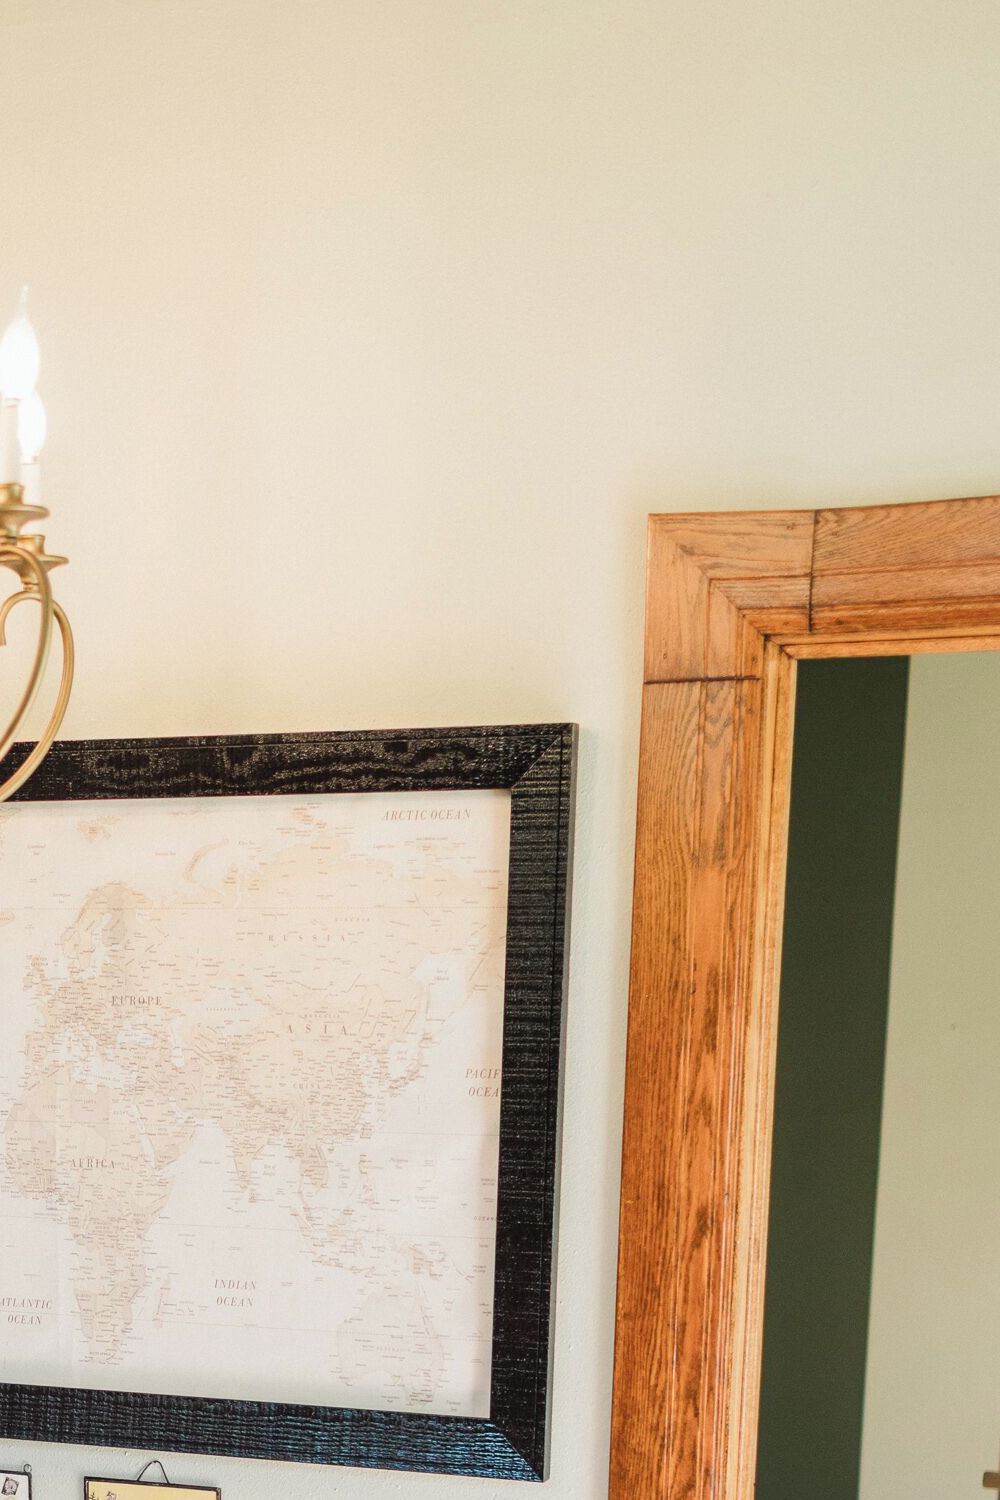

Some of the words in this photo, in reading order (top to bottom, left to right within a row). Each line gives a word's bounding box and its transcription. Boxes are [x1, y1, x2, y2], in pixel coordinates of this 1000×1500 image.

[383, 809, 427, 821] ARCTIC
[430, 808, 472, 820] OCEAN
[112, 995, 162, 1006] EUROPE
[288, 1023, 347, 1036] ASIA
[72, 1158, 115, 1169] AFRICA
[214, 1279, 256, 1290] INDIAN
[0, 1297, 53, 1309] ATLANTIC
[216, 1296, 254, 1307] OCEAN
[7, 1315, 42, 1325] OCEAN
